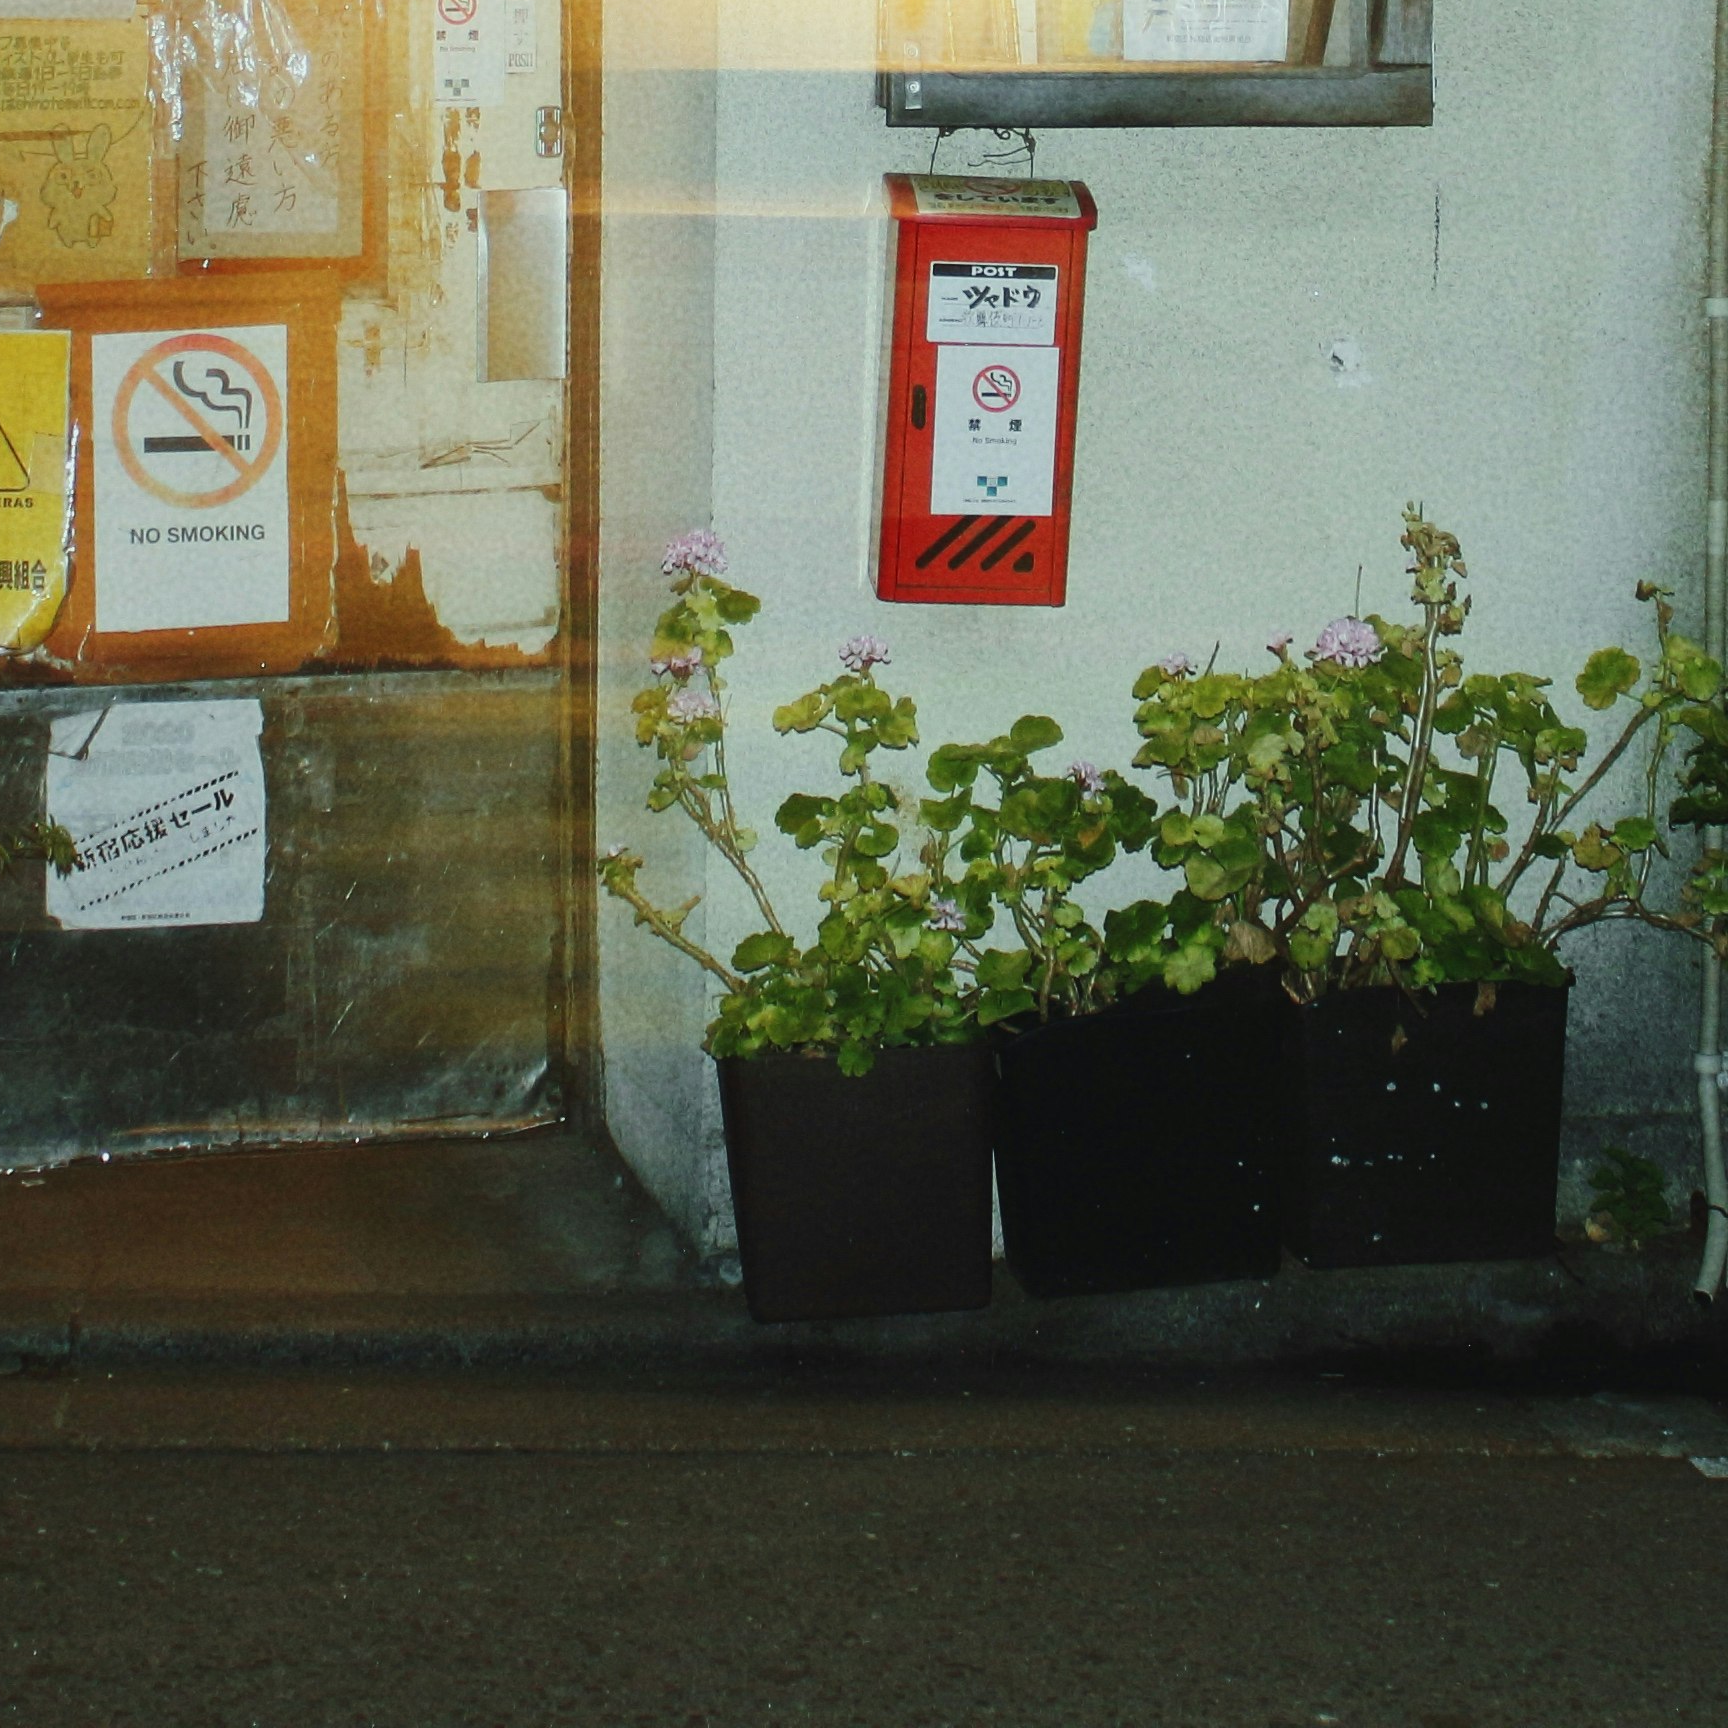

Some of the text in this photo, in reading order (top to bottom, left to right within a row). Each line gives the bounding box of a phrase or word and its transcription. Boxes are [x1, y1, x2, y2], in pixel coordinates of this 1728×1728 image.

[972, 266, 1017, 277] POST
[985, 436, 1018, 446] Smoking
[130, 524, 265, 544] NO SMOKING
